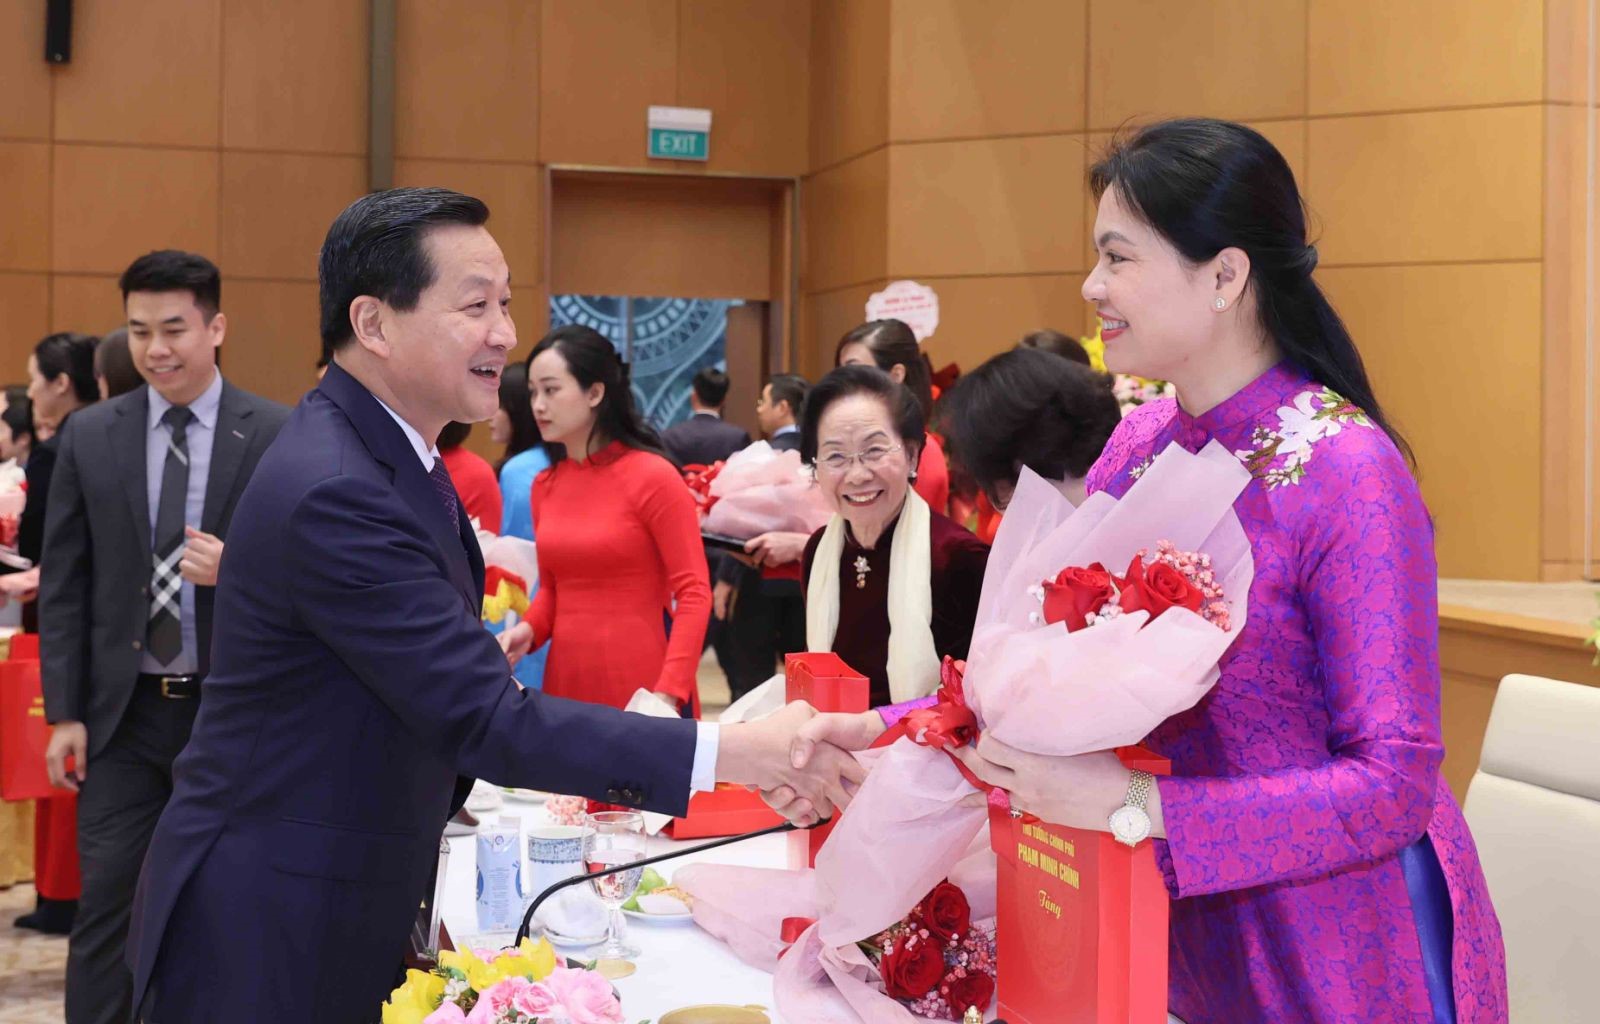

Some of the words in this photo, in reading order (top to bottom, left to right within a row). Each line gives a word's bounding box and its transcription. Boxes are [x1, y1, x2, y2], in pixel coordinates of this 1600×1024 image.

[659, 131, 697, 155] EXIT
[1017, 842, 1039, 869] PHẠM
[1039, 852, 1059, 878] MINH
[1058, 862, 1080, 890] CHÍNH
